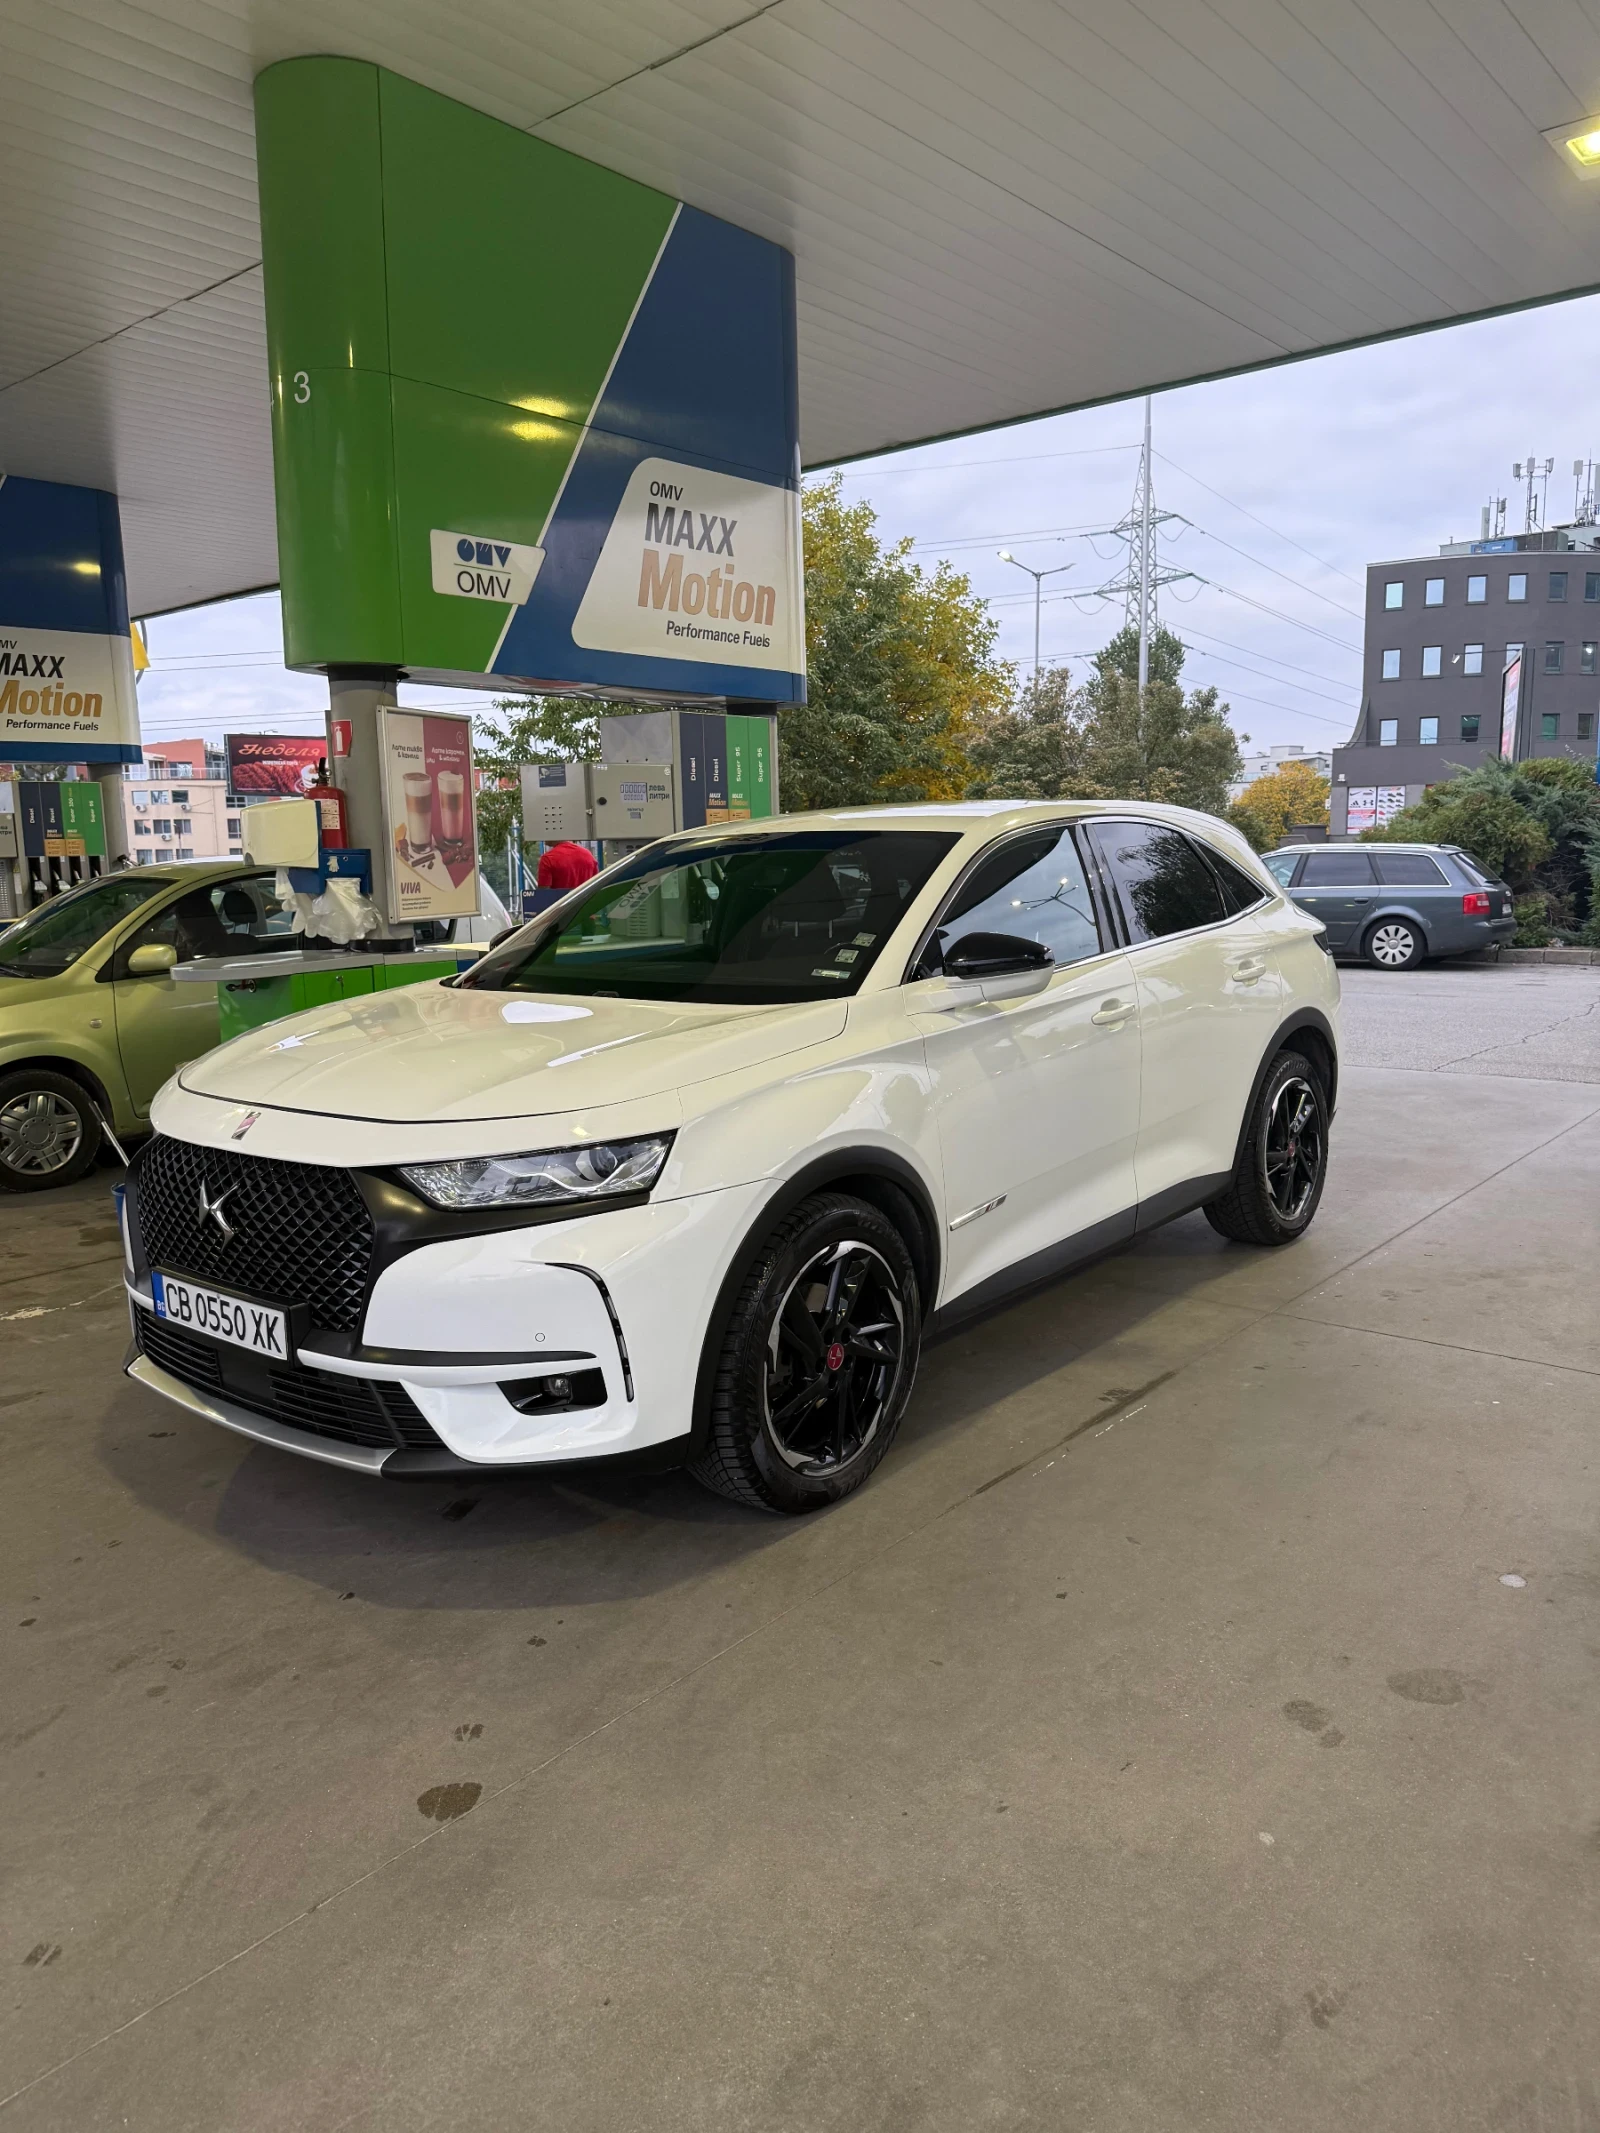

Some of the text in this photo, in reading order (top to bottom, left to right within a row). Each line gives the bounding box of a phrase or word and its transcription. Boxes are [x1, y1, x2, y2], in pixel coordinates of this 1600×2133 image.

[293, 371, 311, 404] 3
[650, 481, 684, 501] OMV
[645, 502, 738, 557] MAXX
[457, 570, 511, 598] OMV
[637, 548, 776, 626] Motion
[0, 640, 18, 650] MV
[666, 620, 771, 648] Performance Fuels
[6, 719, 99, 731] Performance Fuels
[238, 743, 320, 757] Неделя
[649, 793, 670, 801] литри
[400, 881, 421, 895] VIVA
[166, 1283, 283, 1354] CB 0550 XK
